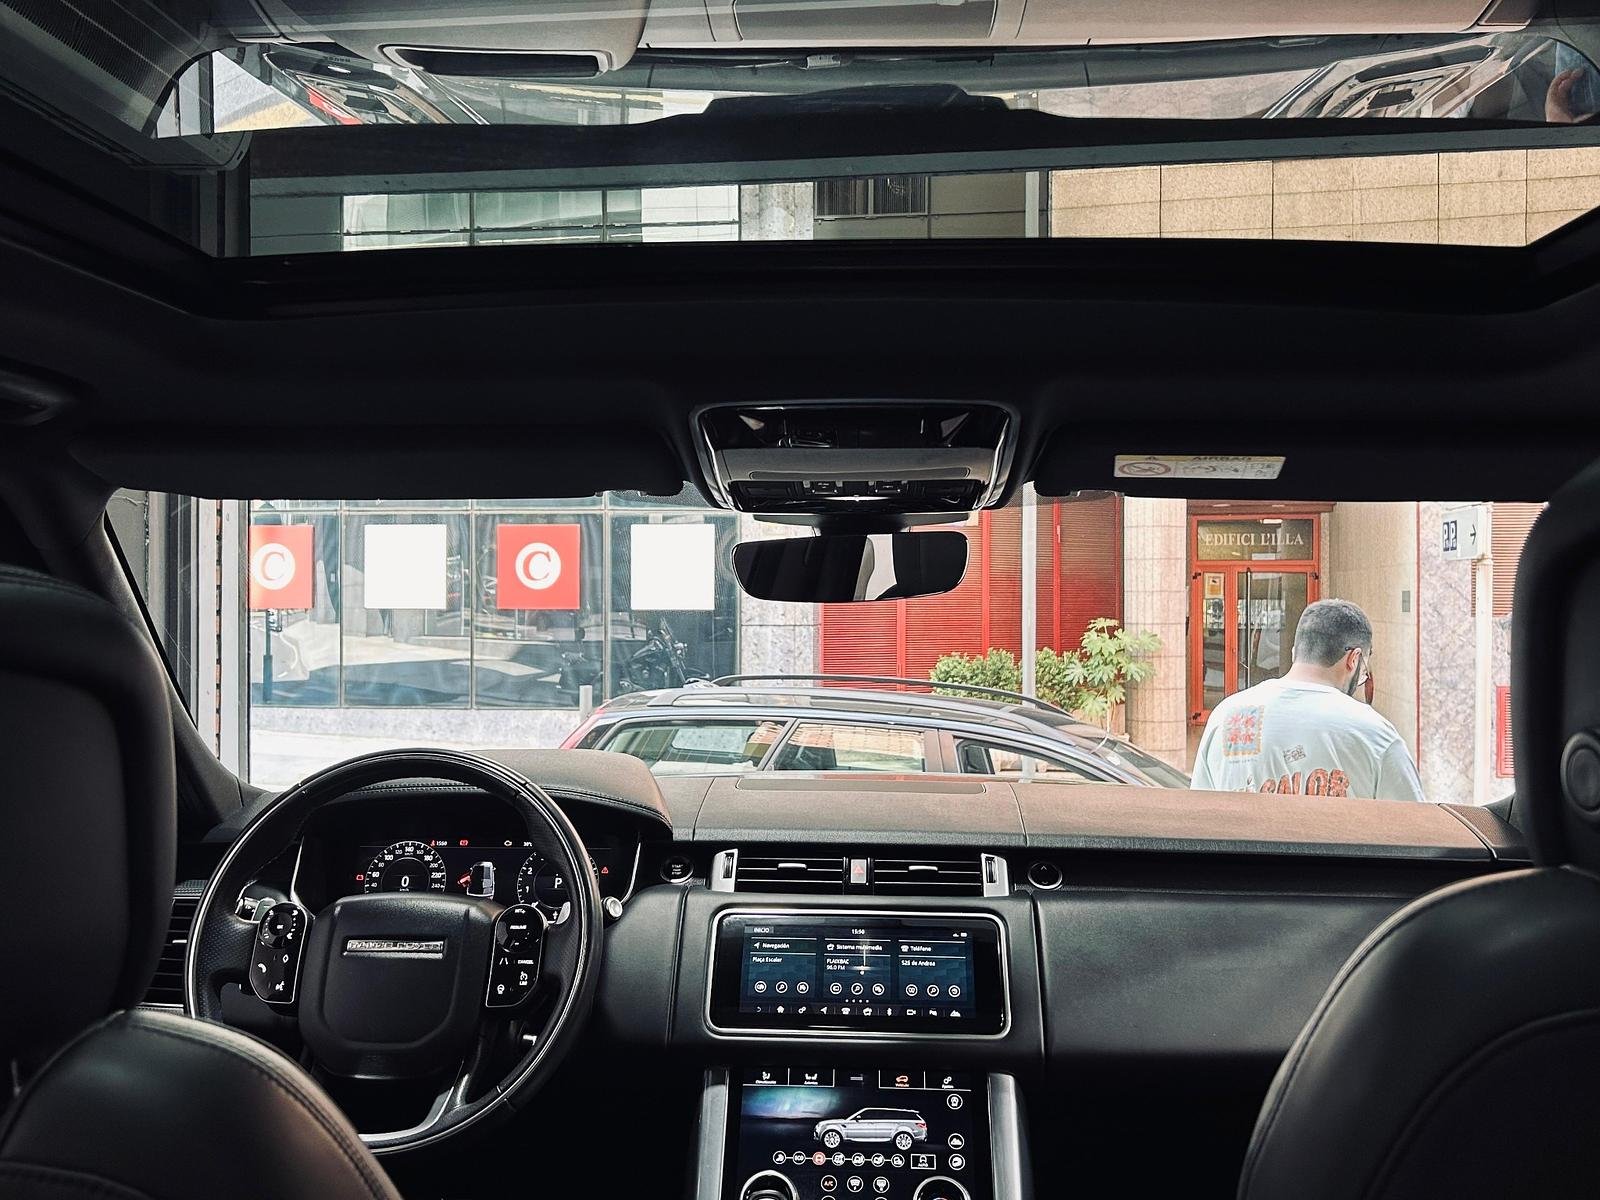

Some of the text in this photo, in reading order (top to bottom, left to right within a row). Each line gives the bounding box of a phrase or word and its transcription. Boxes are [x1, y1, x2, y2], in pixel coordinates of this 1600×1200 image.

[1205, 533, 1255, 546] EDIFICI
[261, 551, 286, 581] C
[522, 550, 552, 581] C
[527, 867, 533, 875] 2
[401, 875, 410, 888] 0
[554, 877, 563, 889] P
